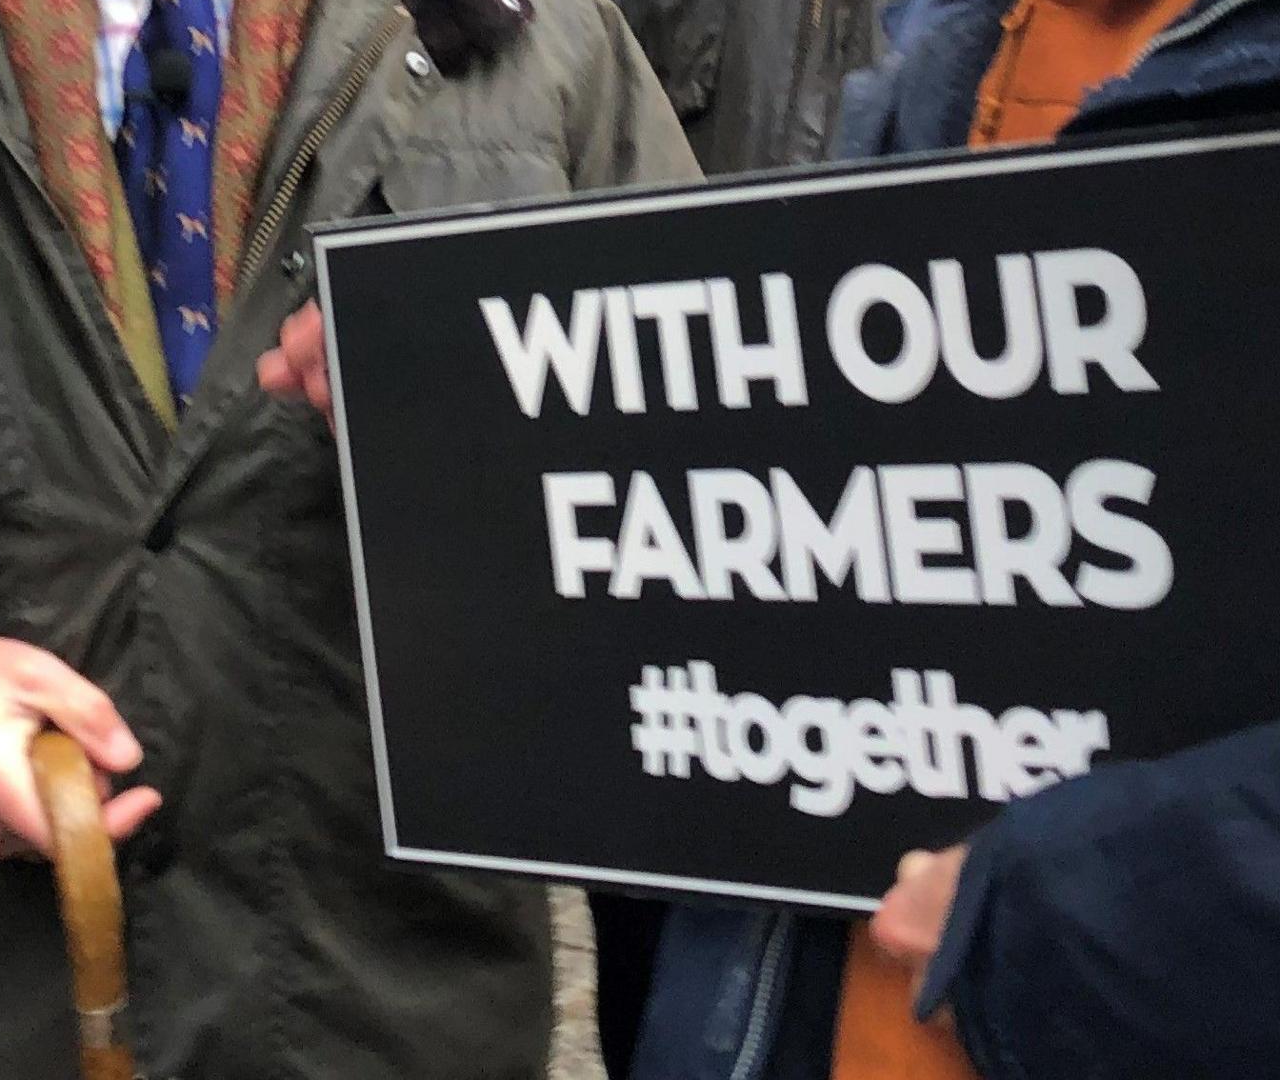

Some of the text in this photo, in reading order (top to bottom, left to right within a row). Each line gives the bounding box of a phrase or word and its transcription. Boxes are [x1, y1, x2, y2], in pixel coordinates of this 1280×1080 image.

[478, 247, 1161, 419] WITH OUR
[542, 458, 1175, 610] FARMERS
[629, 660, 1111, 817] #together
